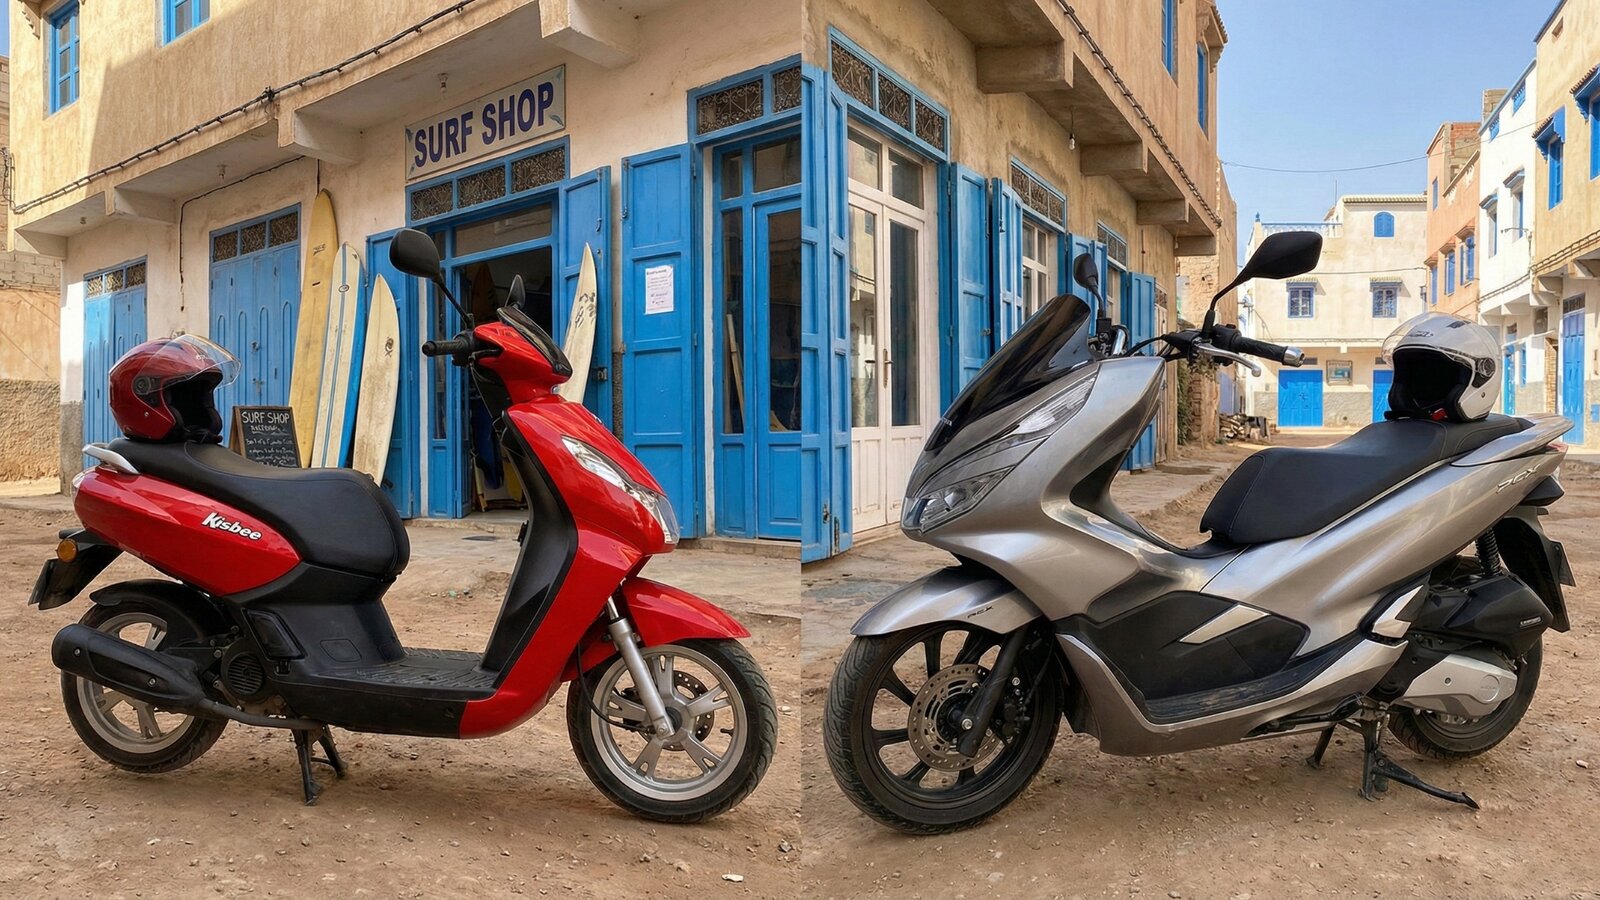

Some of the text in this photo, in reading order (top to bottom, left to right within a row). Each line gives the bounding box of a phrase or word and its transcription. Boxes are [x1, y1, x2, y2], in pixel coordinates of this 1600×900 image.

[414, 81, 554, 168] SURF SHOP
[241, 411, 290, 424] SURF SHOP
[201, 511, 262, 540] Kisbee
